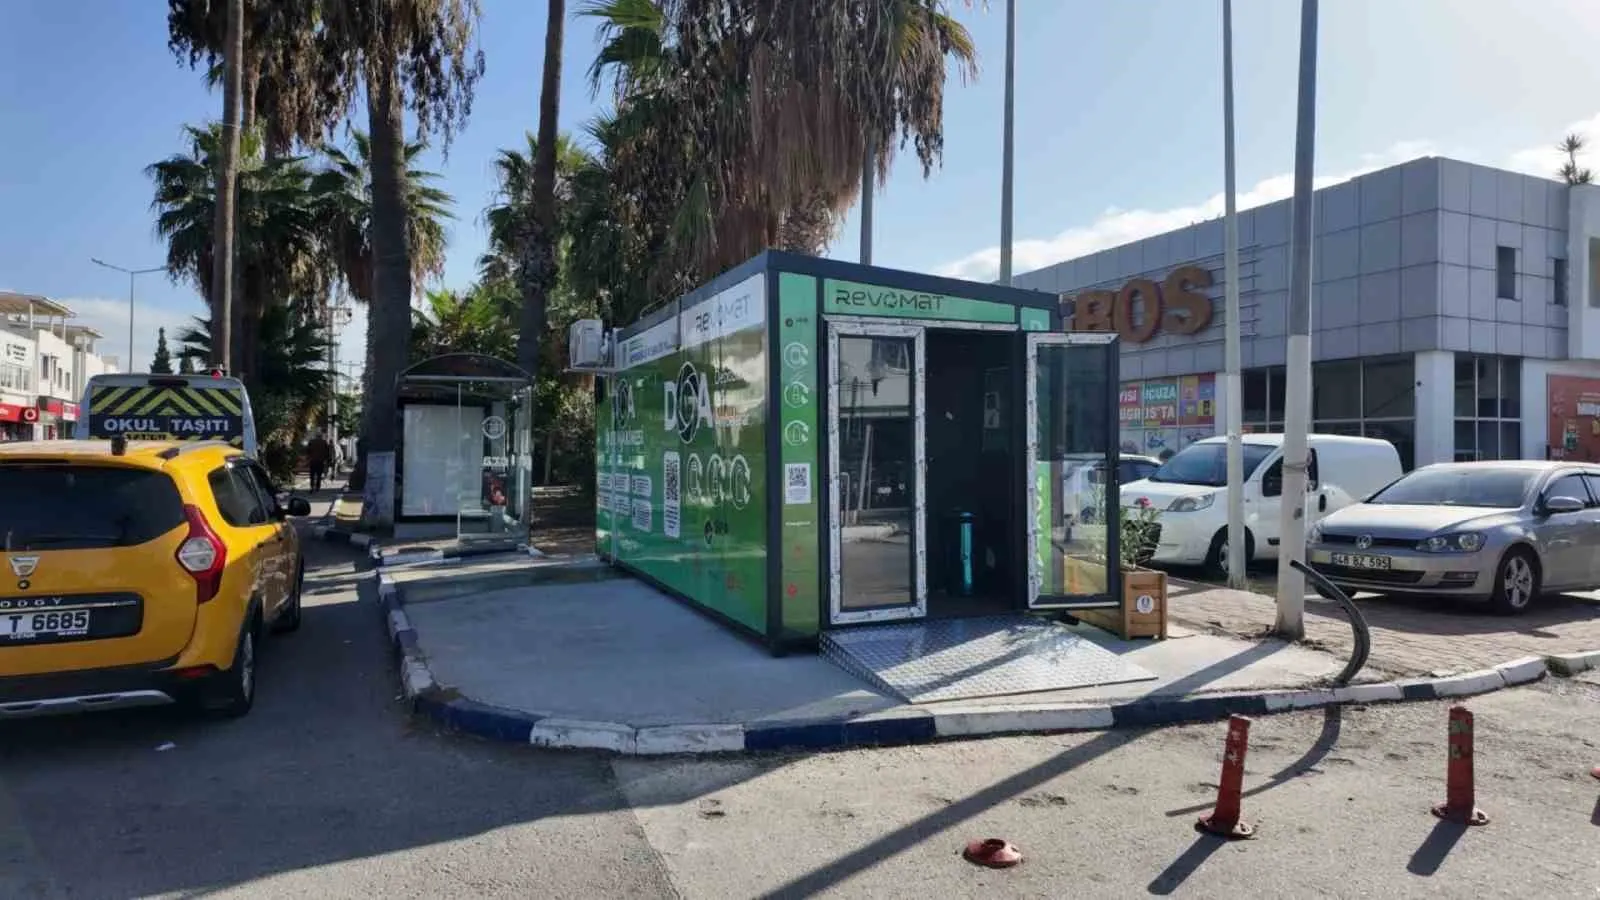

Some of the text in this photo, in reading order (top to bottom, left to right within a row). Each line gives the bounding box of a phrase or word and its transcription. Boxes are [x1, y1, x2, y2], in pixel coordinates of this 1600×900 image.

[103, 418, 229, 433] OKUL TAŞITI
[9, 612, 88, 633] T 6685
